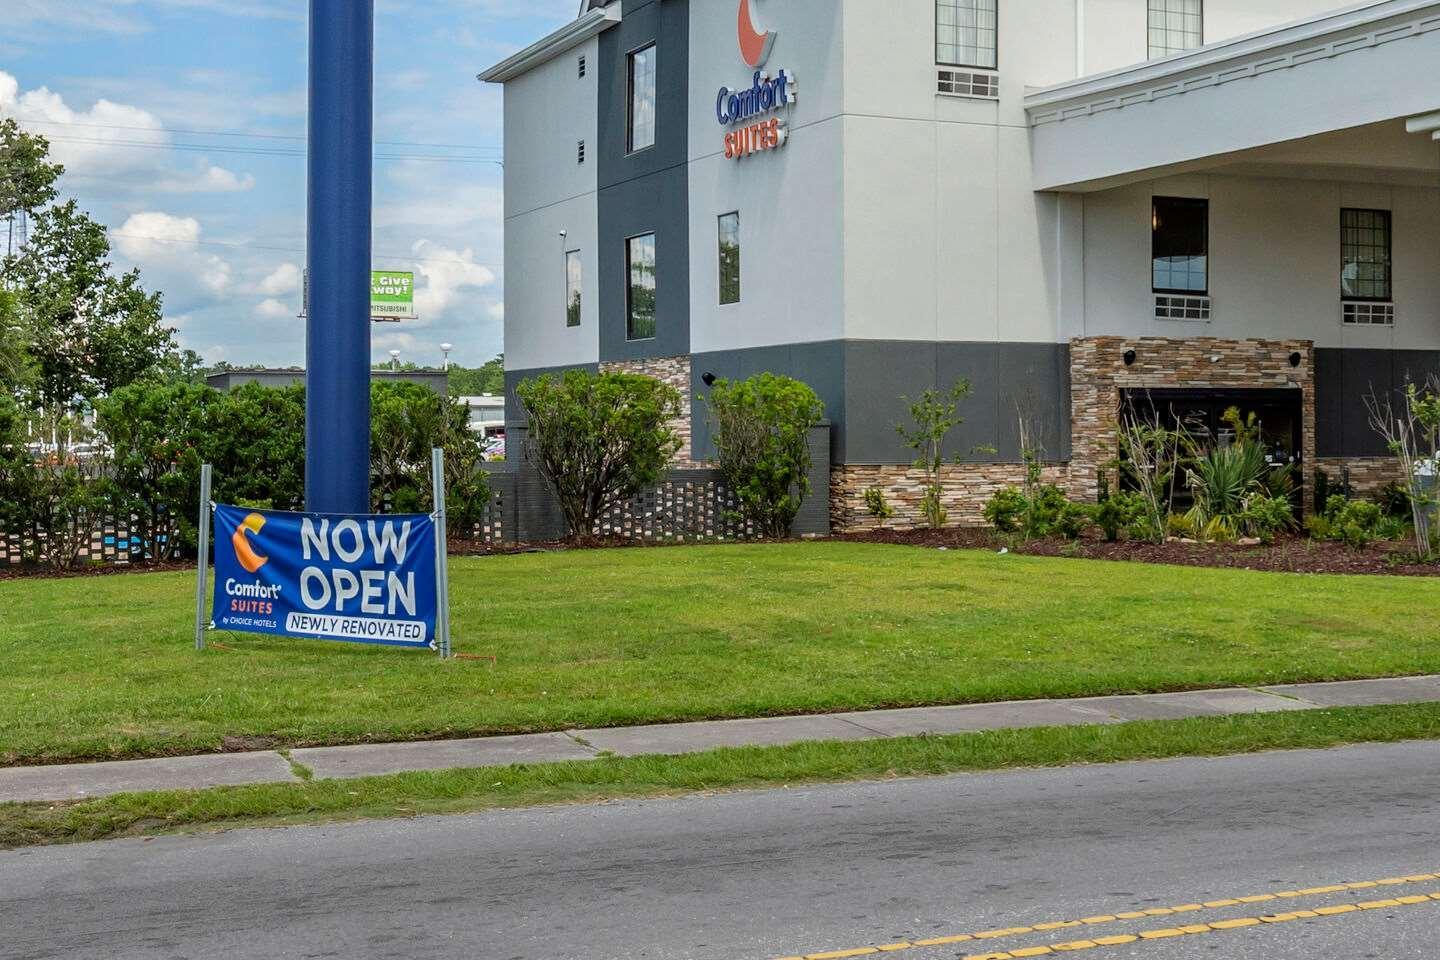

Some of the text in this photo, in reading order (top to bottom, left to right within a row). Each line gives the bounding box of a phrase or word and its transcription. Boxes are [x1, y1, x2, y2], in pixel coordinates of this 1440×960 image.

[716, 68, 789, 125] Comfort
[724, 117, 779, 160] SUITES
[300, 517, 412, 565] NOW
[231, 599, 273, 615] SUITES
[300, 566, 417, 616] OPEN
[229, 616, 252, 626] CHOICE
[253, 618, 278, 628] HOTELS
[290, 615, 421, 639] NEWLY RENOVATED
